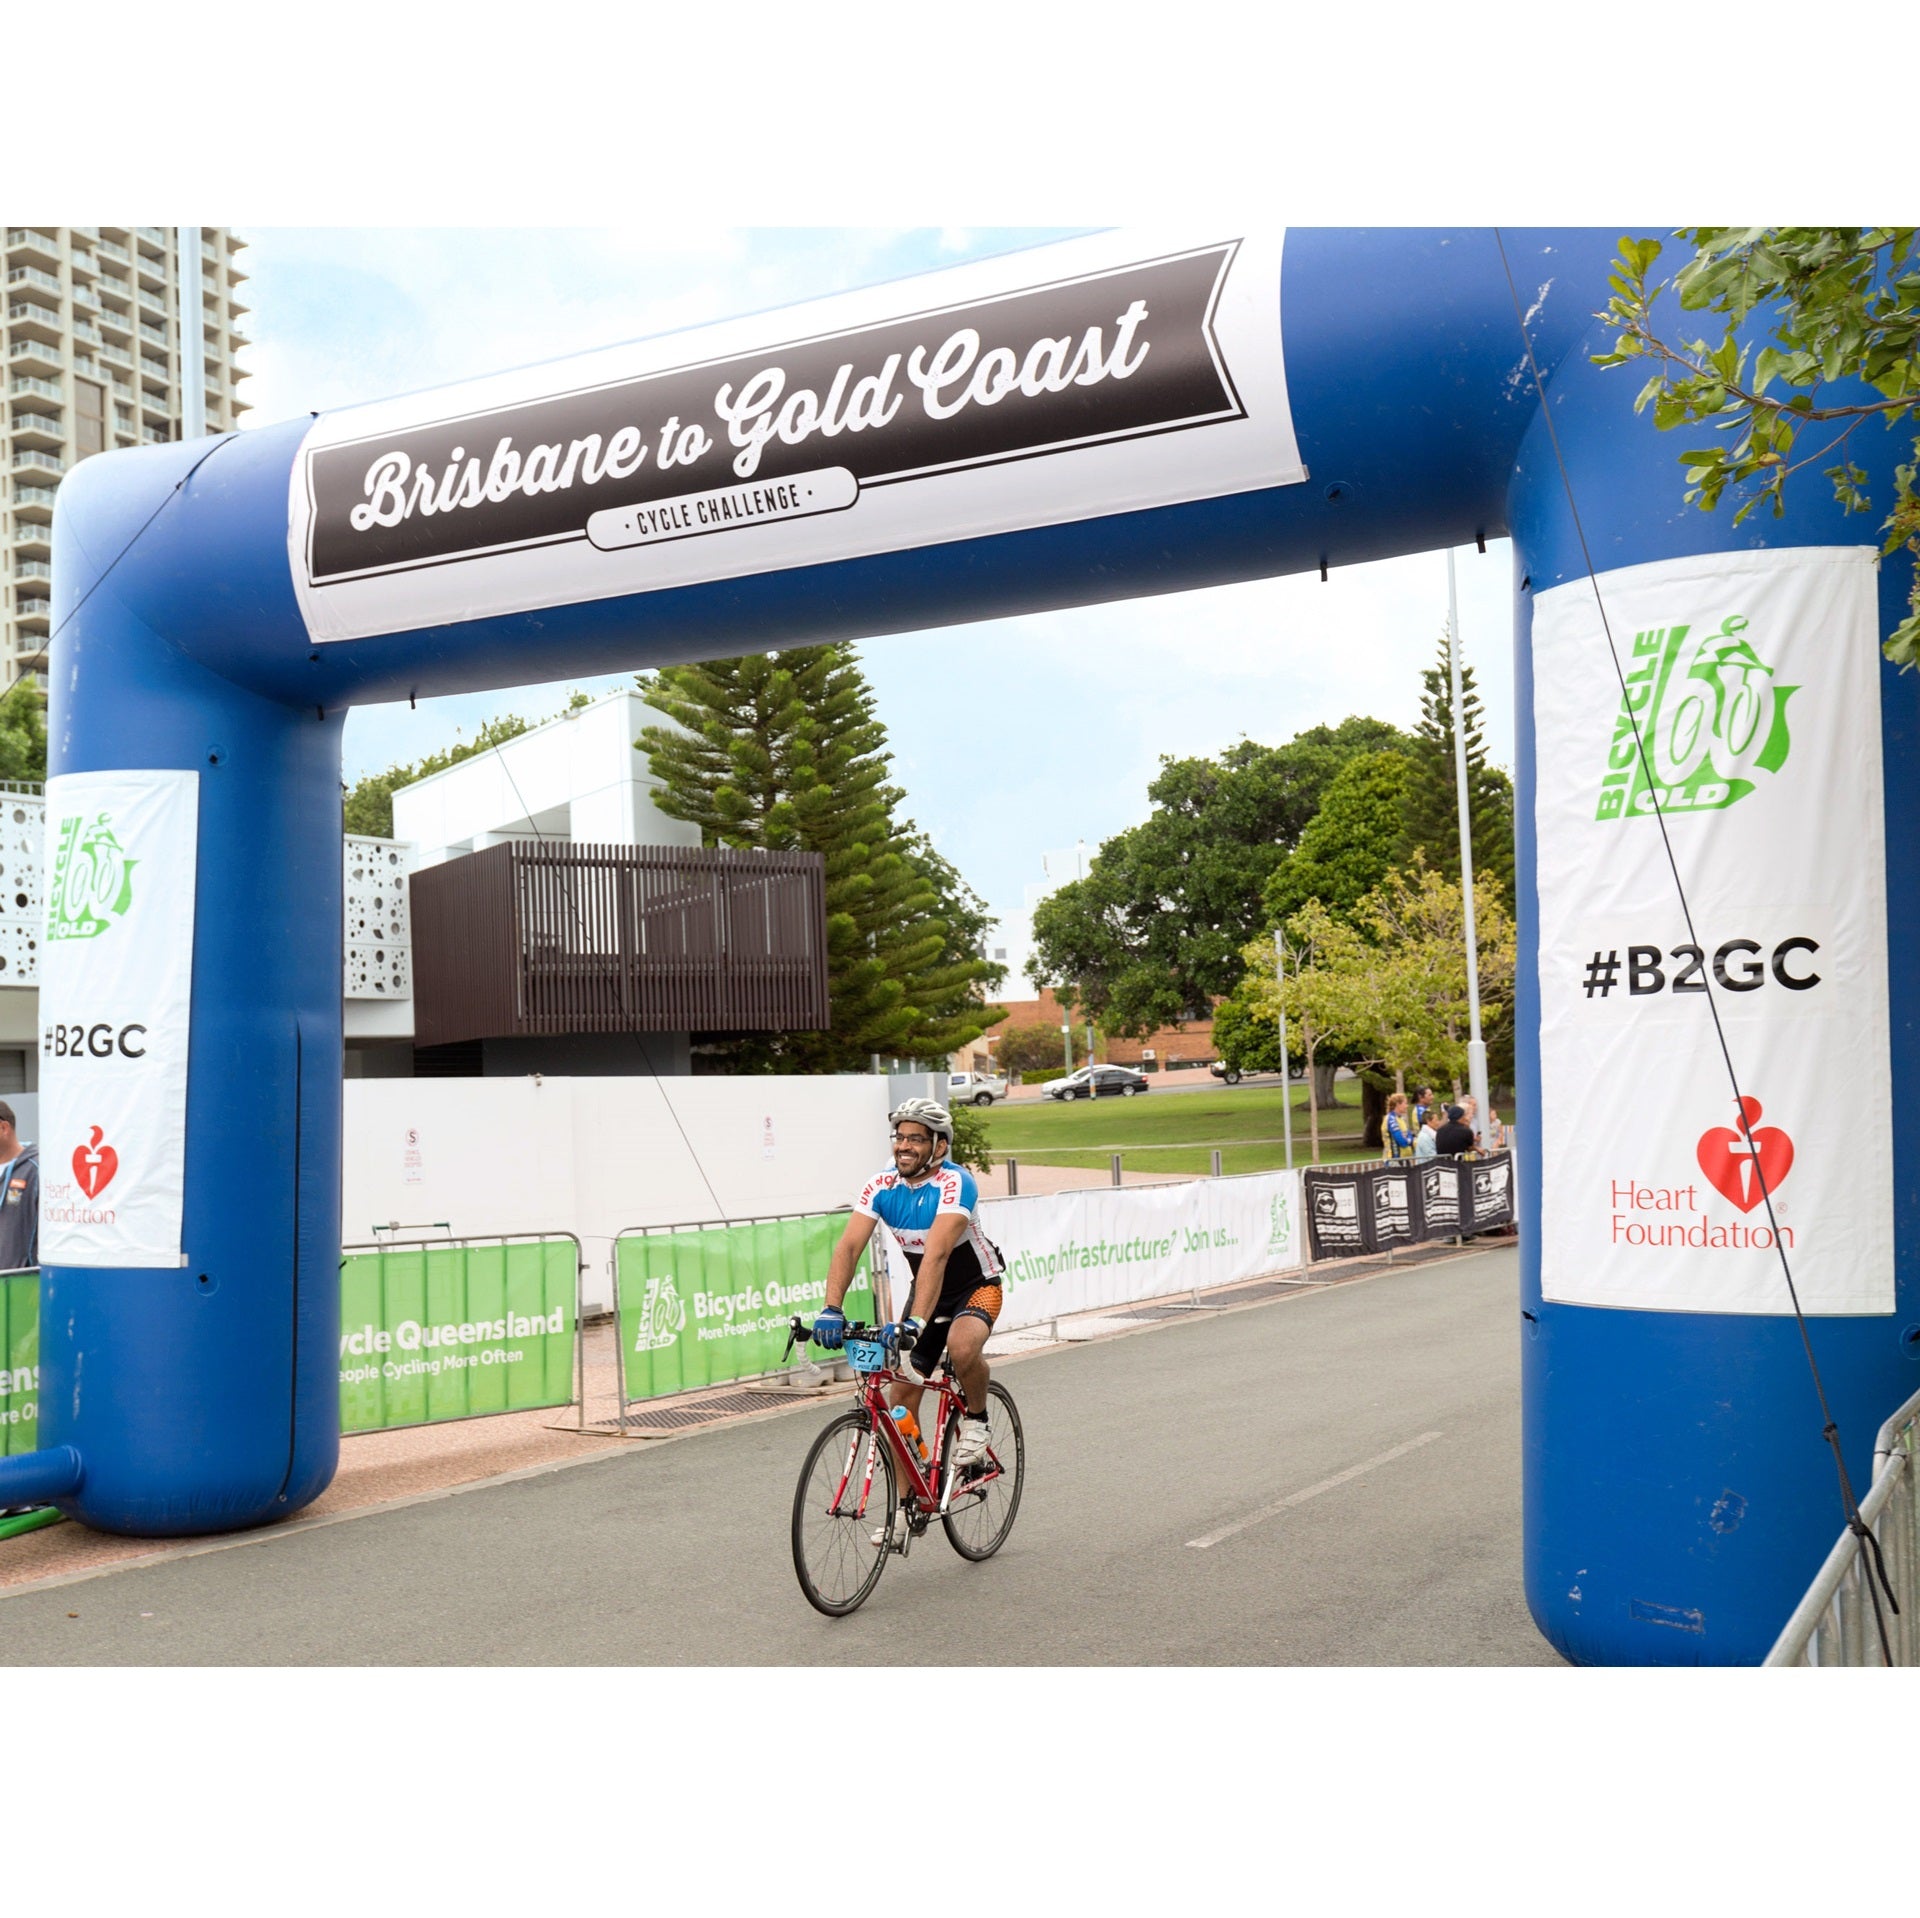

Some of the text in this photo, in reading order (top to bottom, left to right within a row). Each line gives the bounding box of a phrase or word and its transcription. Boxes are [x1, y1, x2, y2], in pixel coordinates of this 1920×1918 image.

[351, 300, 1150, 531] Brisbane to Gold Coast
[636, 483, 801, 535] CYCLE CHALLENGE
[1595, 628, 1665, 821] BICYCLE
[1634, 783, 1730, 812] QLD
[57, 920, 97, 938] QLD
[1582, 936, 1822, 999] #B2GC
[45, 1023, 148, 1059] #B2GC
[1611, 1179, 1698, 1211] Heart
[1184, 1226, 1209, 1253] Join
[1612, 1214, 1795, 1249] Foundation
[693, 1285, 763, 1322] Bicycle
[396, 1306, 564, 1351] Queensland
[697, 1326, 723, 1342] More
[724, 1320, 757, 1338] People
[383, 1357, 440, 1380] Cycling
[443, 1353, 477, 1371] More
[481, 1349, 523, 1366] Often
